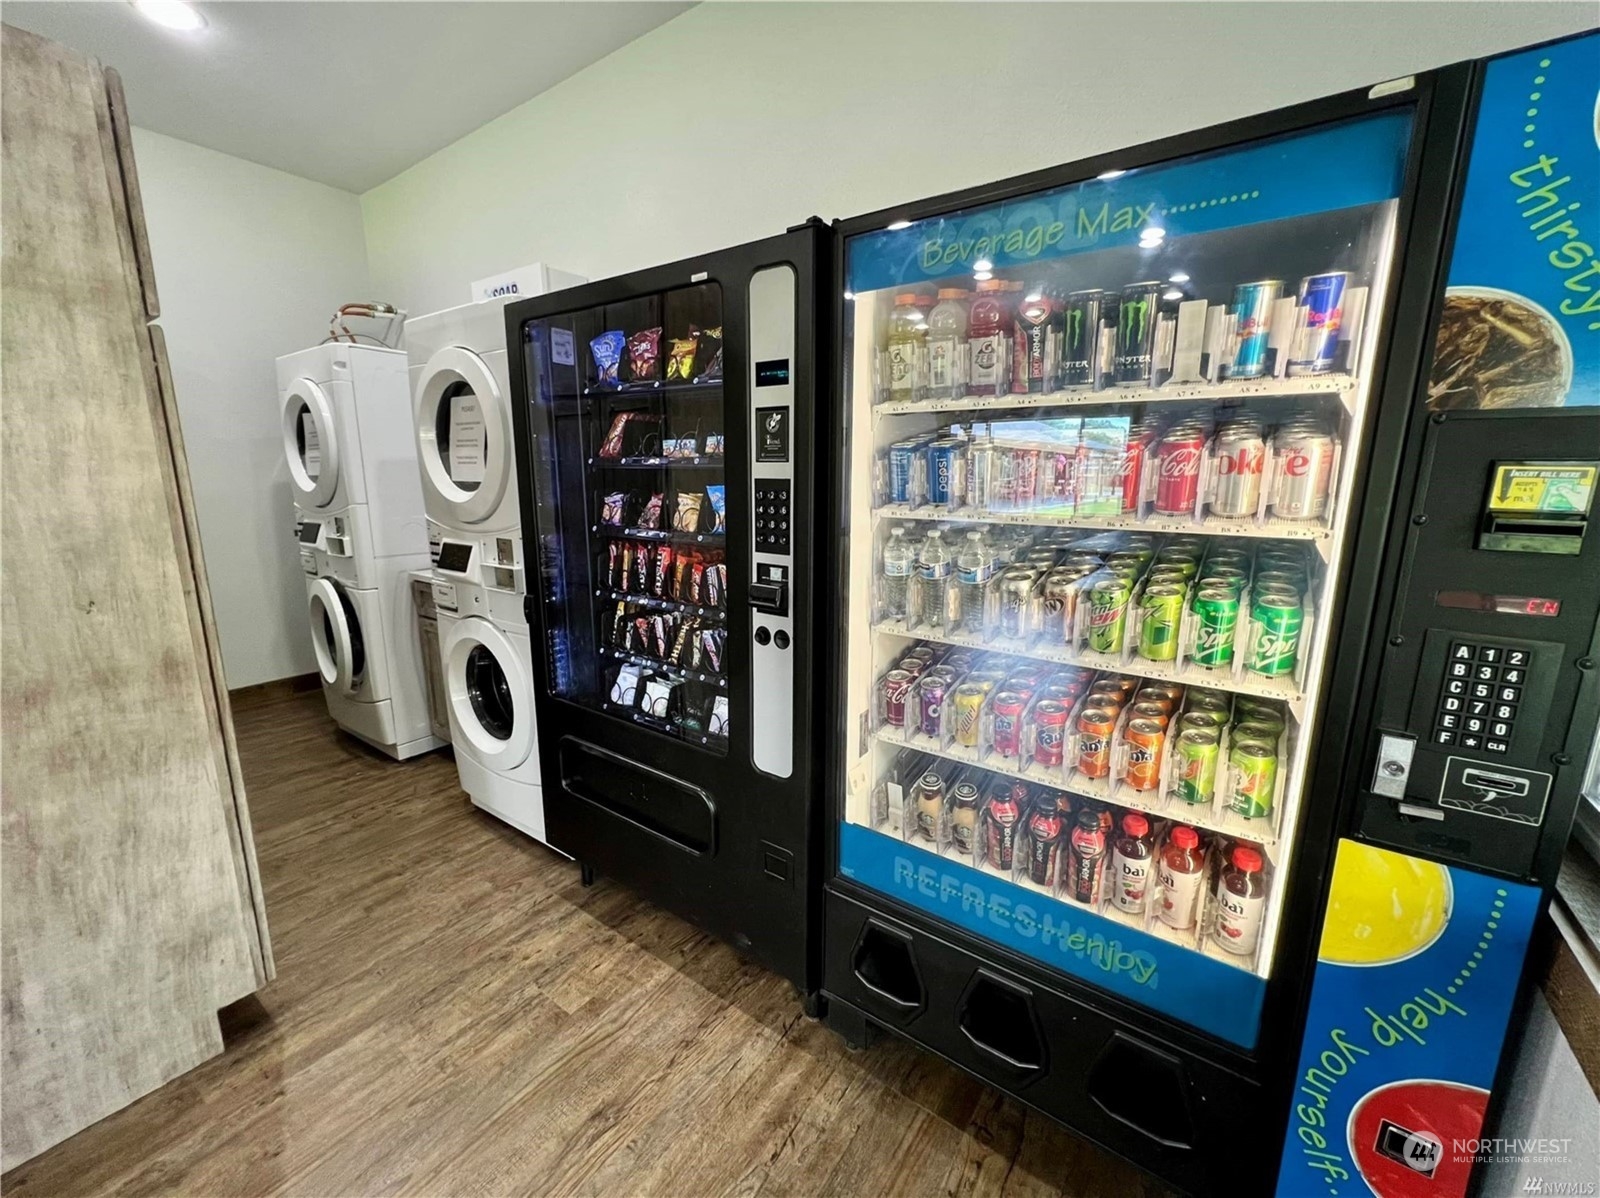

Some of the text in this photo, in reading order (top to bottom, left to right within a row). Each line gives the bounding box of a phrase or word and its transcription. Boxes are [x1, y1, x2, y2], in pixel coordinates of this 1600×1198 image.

[923, 201, 1157, 268] Beverage Max
[1219, 448, 1265, 475] oke
[938, 457, 949, 492] pepsi
[1510, 469, 1539, 477] INSERT
[1456, 646, 1523, 665] A 1 2
[1453, 664, 1519, 682] B 3 4
[1450, 681, 1514, 701] C 5 6
[1446, 698, 1511, 718] D 7 8
[1443, 715, 1507, 736] E 9 0
[1081, 739, 1110, 752] anta
[1439, 732, 1506, 752] F CLR
[1131, 749, 1153, 762] nta
[1067, 931, 1158, 984] enjoy
[1296, 987, 1468, 1181] help yourself
